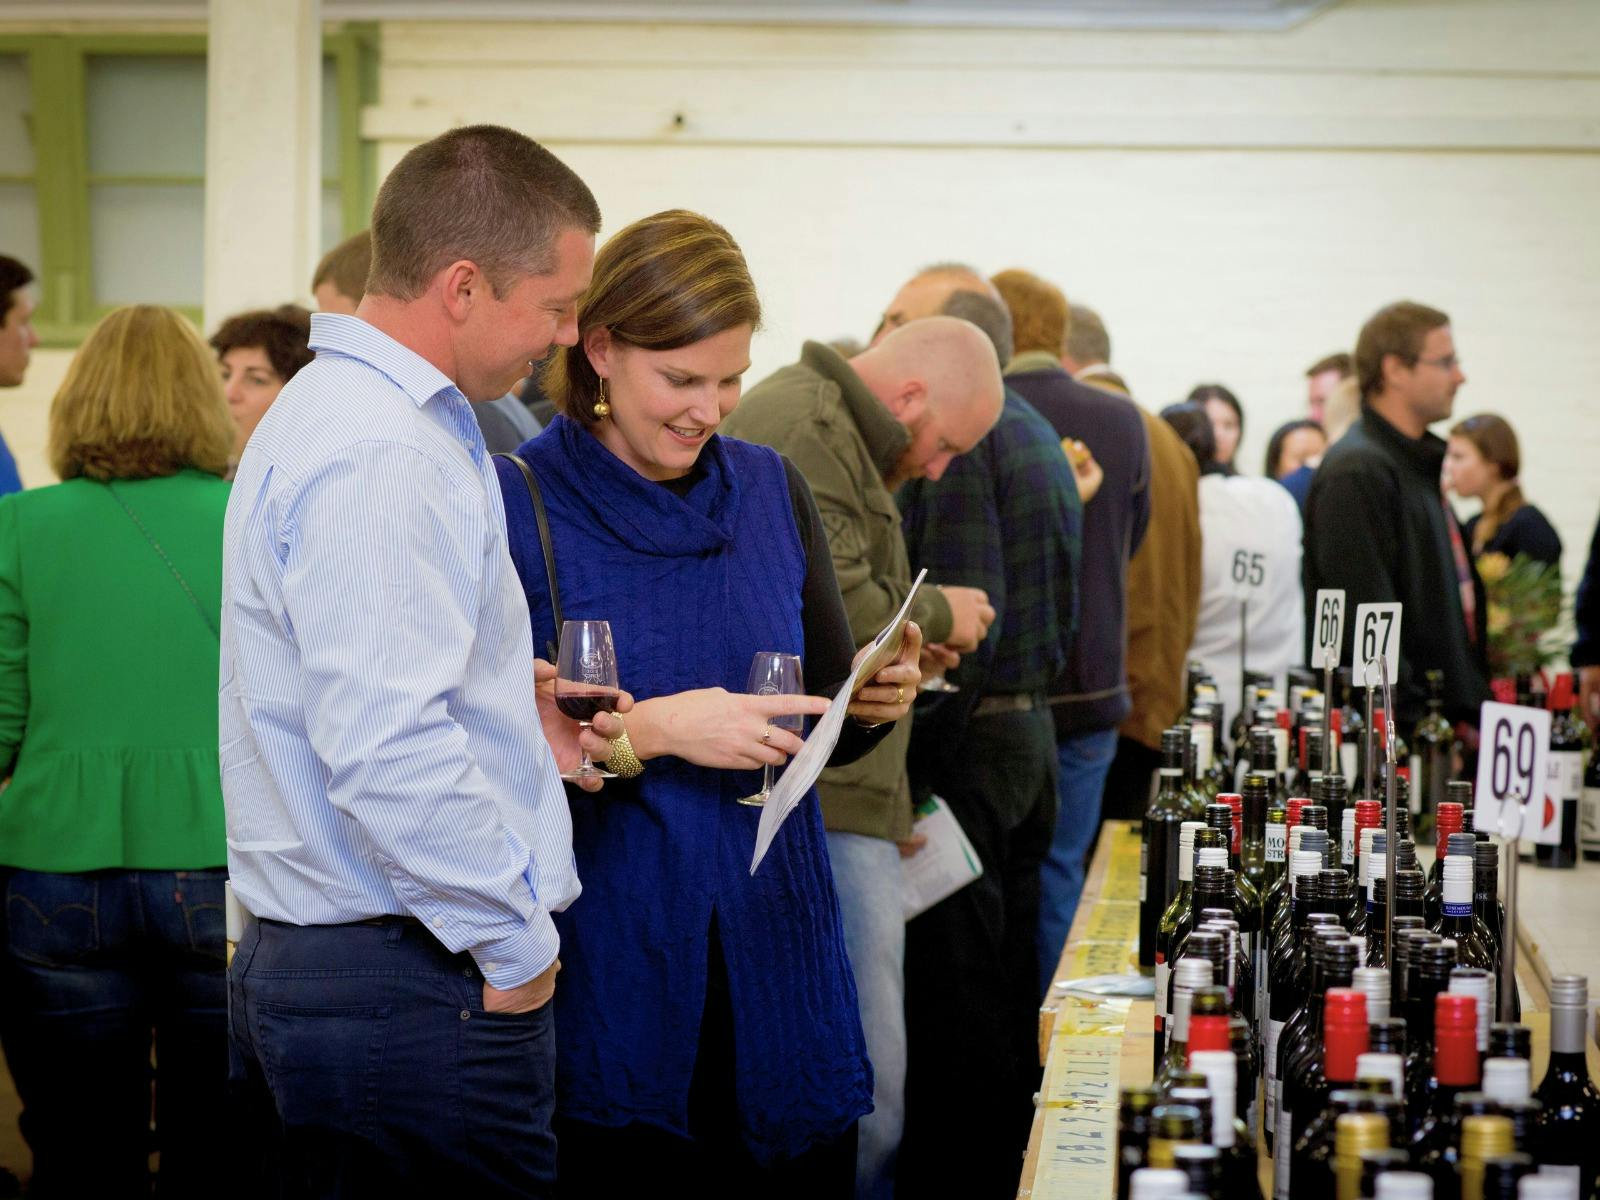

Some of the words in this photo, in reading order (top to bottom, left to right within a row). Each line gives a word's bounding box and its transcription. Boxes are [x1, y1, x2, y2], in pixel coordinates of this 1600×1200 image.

[1231, 549, 1265, 586] 65
[1320, 597, 1341, 649] 66
[1362, 610, 1394, 665] 67
[1492, 717, 1536, 806] 69
